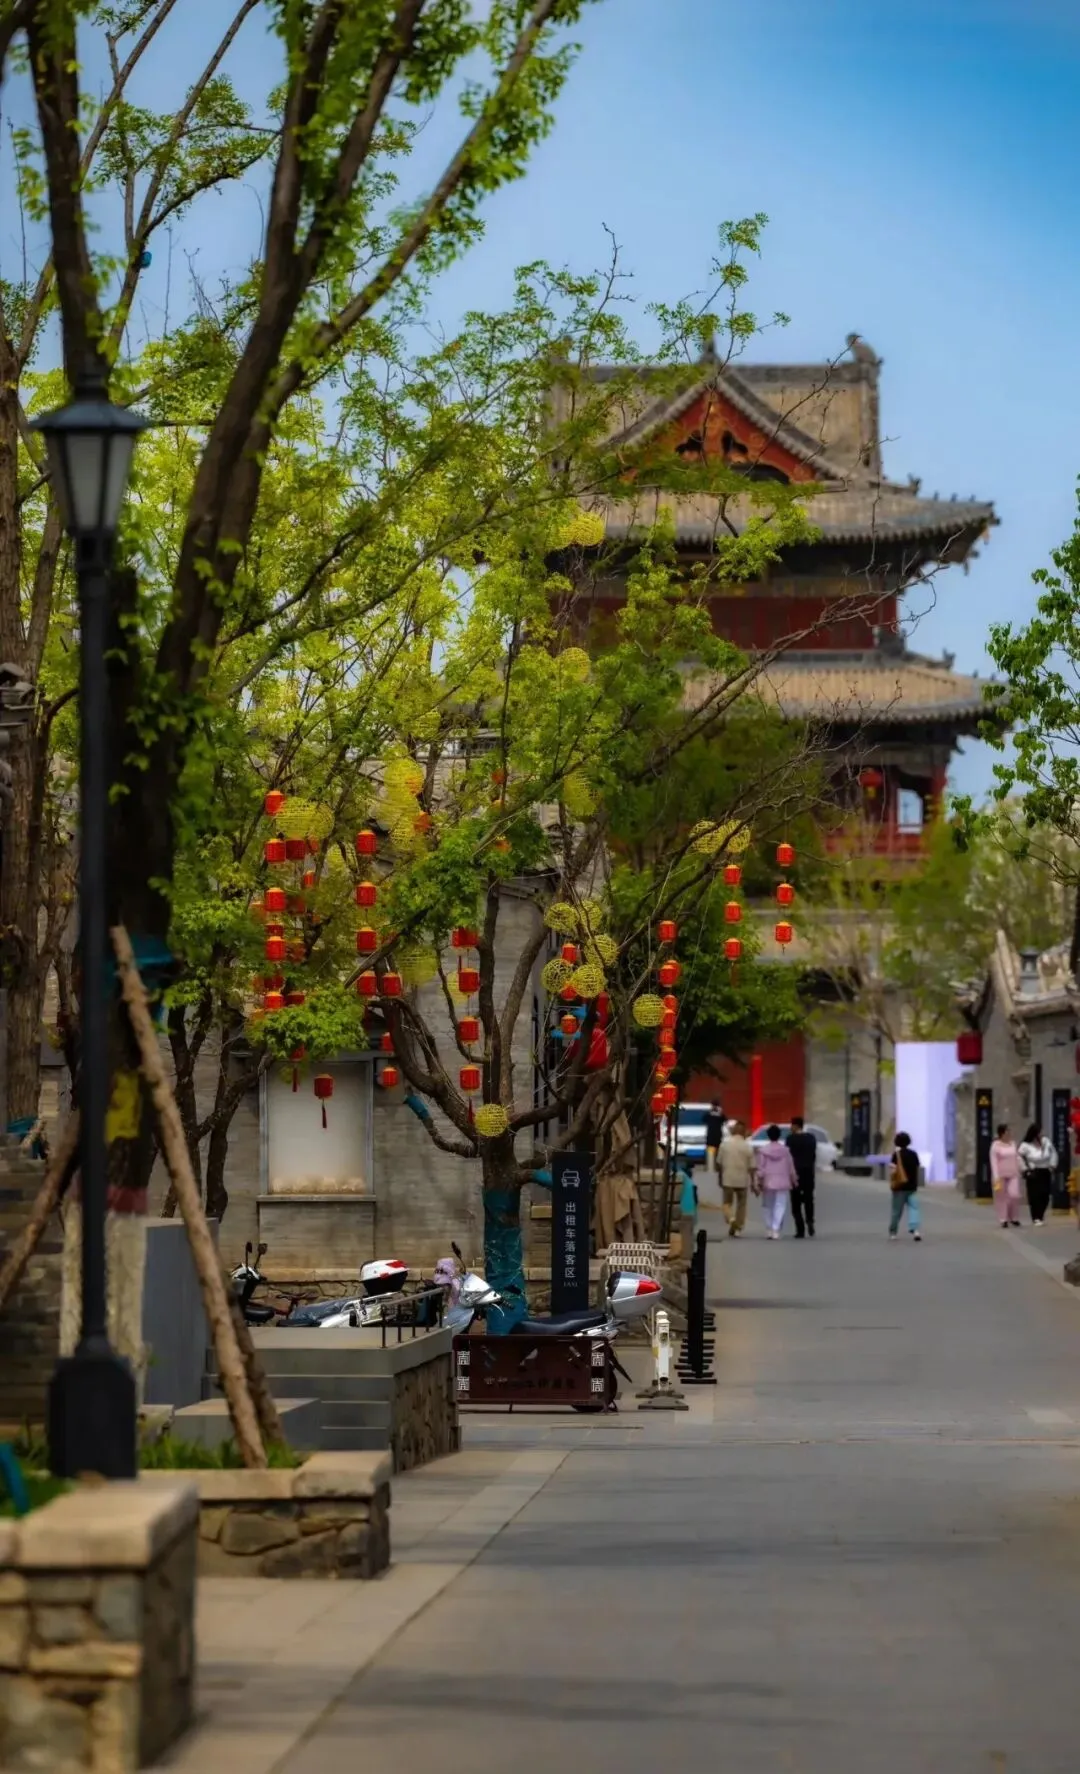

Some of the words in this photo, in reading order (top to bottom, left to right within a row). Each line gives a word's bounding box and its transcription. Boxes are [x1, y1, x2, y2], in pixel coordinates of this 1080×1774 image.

[564, 1201, 577, 1278] 出租车落客区
